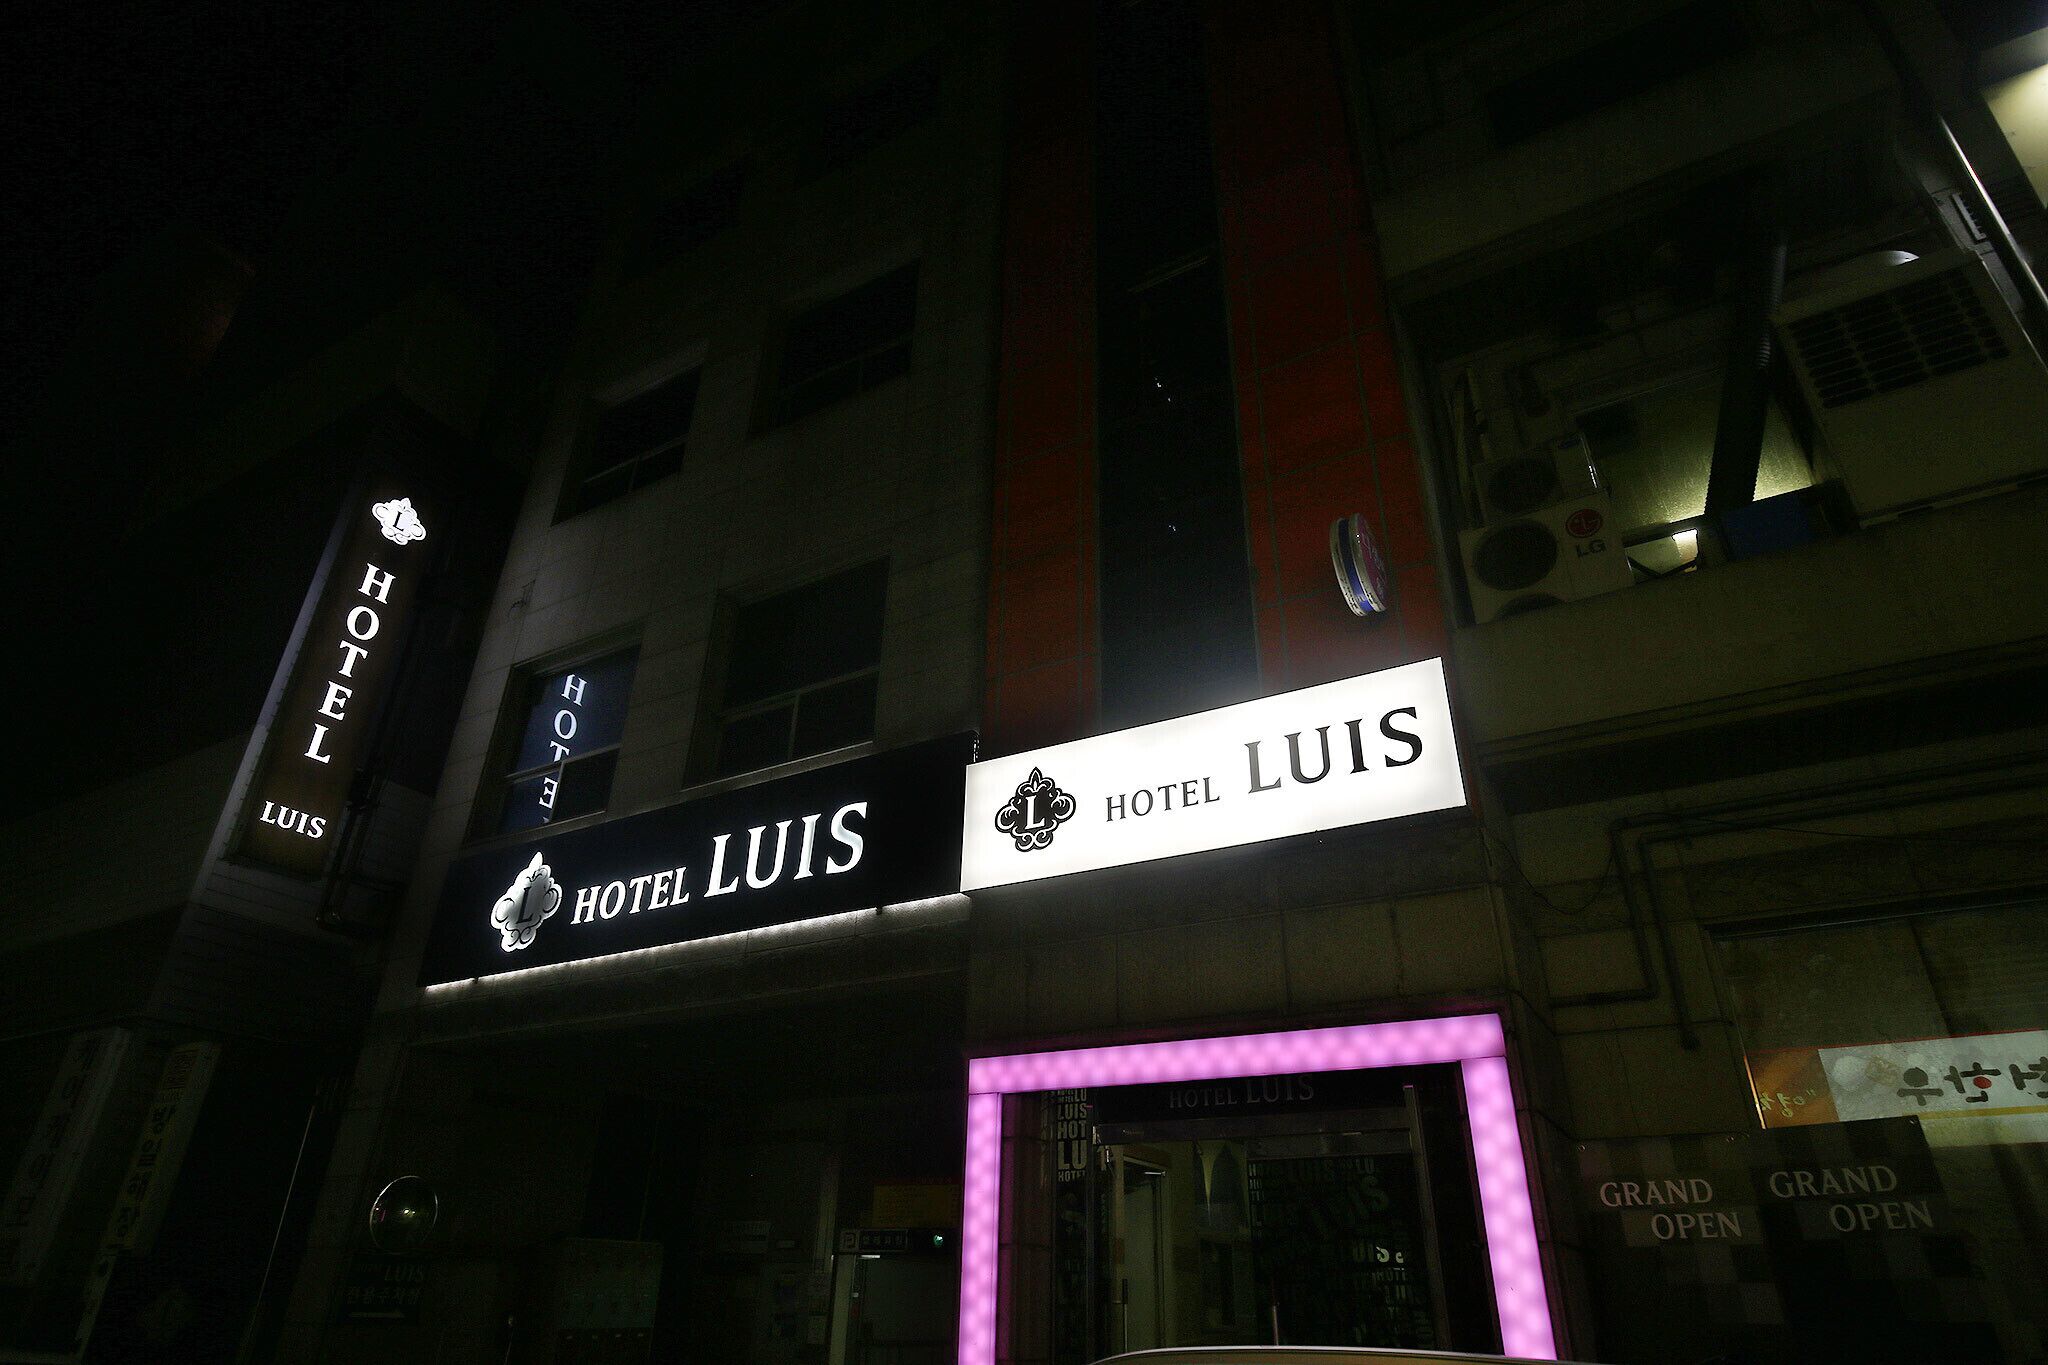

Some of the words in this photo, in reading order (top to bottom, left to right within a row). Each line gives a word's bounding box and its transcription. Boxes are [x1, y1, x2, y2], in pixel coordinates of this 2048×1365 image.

[1575, 538, 1607, 558] LG
[304, 563, 396, 764] HOTEL
[1106, 777, 1220, 822] HOTEL
[1245, 706, 1424, 794] LUIS
[260, 800, 327, 839] LUIS
[570, 867, 690, 925] HOTEL
[703, 802, 868, 898] LUIS
[1168, 1087, 1238, 1109] HOTEL
[1246, 1073, 1315, 1104] LUIS
[1600, 1179, 1714, 1209] GRAND
[1769, 1164, 1898, 1200] GRAND
[1651, 1211, 1744, 1241] OPEN
[1829, 1201, 1935, 1234] OPEN
